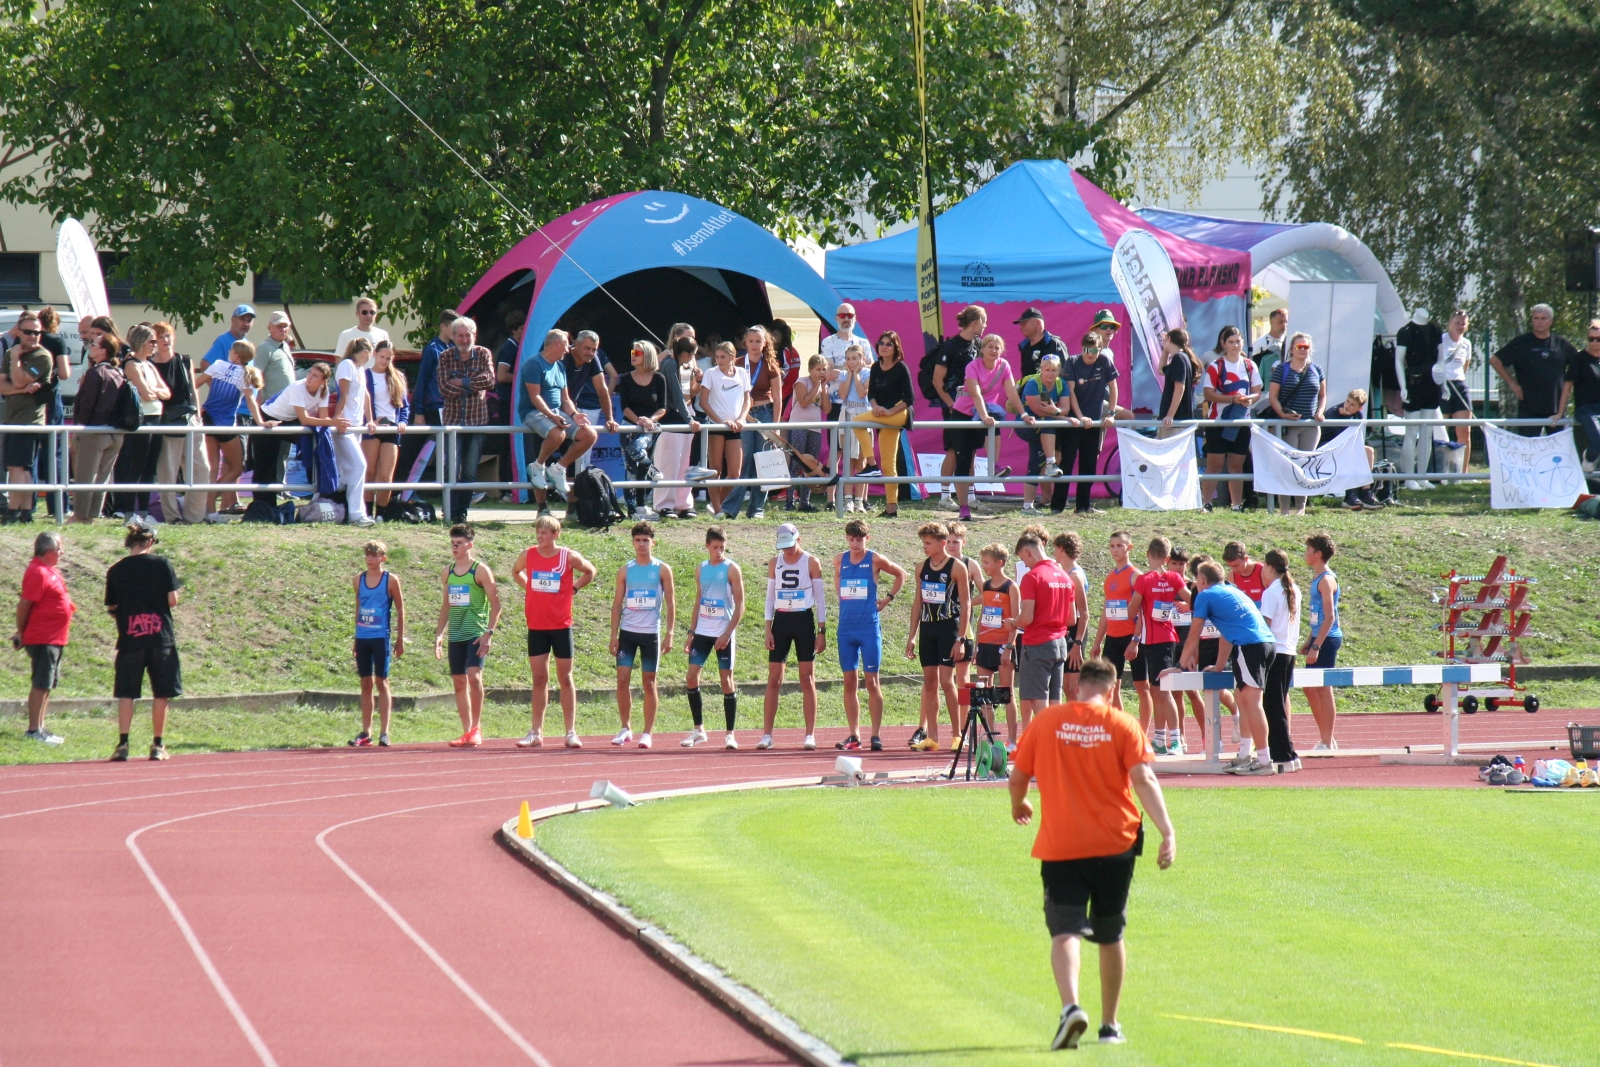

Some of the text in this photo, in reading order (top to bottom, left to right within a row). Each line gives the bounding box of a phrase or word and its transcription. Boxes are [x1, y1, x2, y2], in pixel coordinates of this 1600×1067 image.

[671, 209, 736, 256] #JsemAtlet
[1198, 263, 1239, 286] BLANSKO
[782, 570, 799, 589] S
[1056, 731, 1111, 742] TIMEKEEPER
[1062, 723, 1105, 734] OFFICIAL
